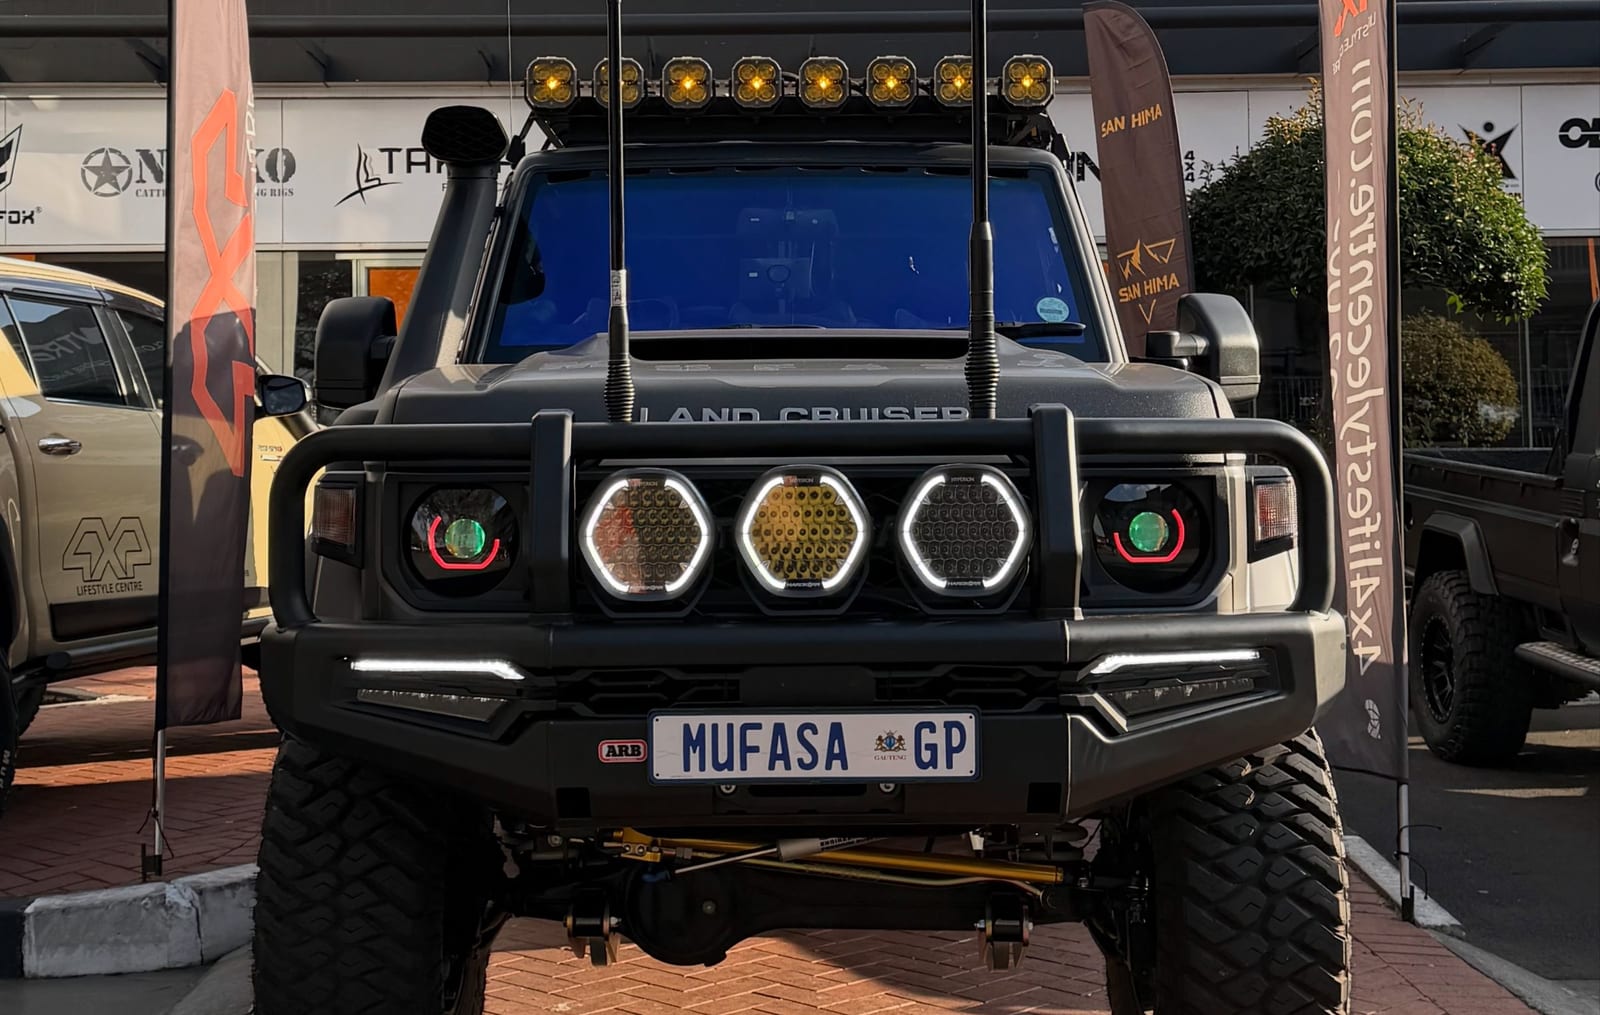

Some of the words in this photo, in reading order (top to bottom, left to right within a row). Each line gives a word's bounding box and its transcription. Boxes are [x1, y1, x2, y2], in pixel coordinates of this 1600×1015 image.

[1101, 115, 1126, 138] SAN
[1131, 103, 1163, 129] HIMA
[270, 188, 294, 197] RIGS
[1118, 282, 1141, 303] SAN
[1143, 272, 1180, 296] HIMA
[76, 583, 114, 597] LIFESTYLE
[115, 580, 143, 594] CENTRE
[605, 744, 642, 757] ARB
[682, 722, 849, 772] MUFASA
[914, 720, 967, 770] GP
